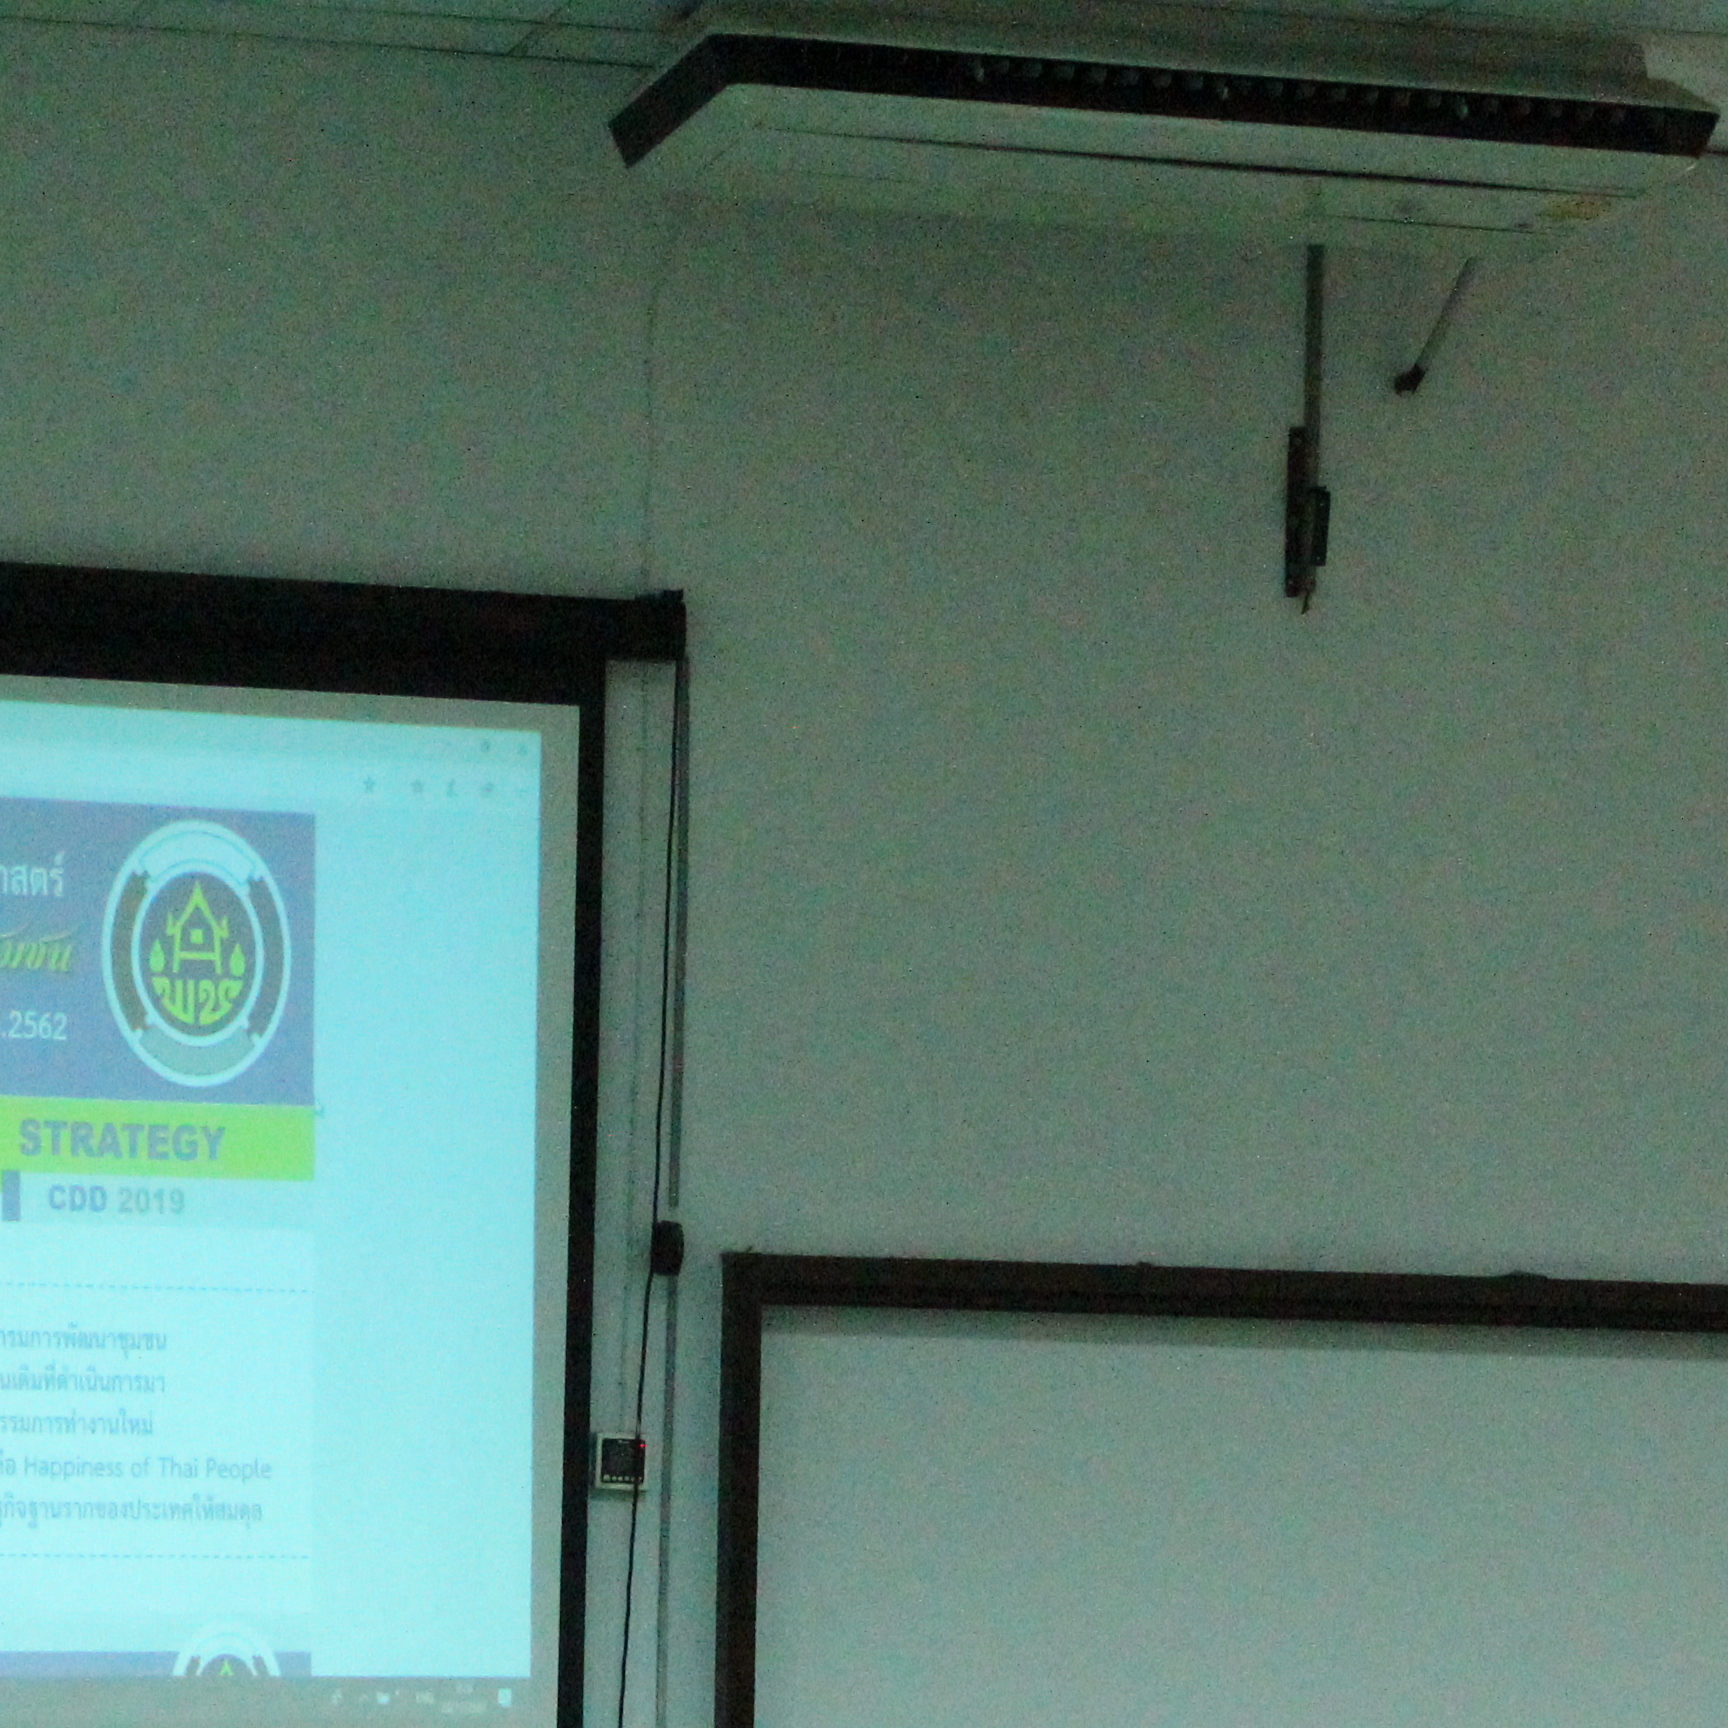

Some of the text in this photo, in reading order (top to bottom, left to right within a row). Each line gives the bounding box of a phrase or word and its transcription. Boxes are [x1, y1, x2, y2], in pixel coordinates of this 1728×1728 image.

[17, 1118, 227, 1162] STRATEGY
[47, 1184, 186, 1215] CDD 2019
[24, 1456, 124, 1483] Happiness
[130, 1454, 152, 1478] of
[158, 1457, 199, 1480] Thai
[206, 1457, 273, 1483] People
